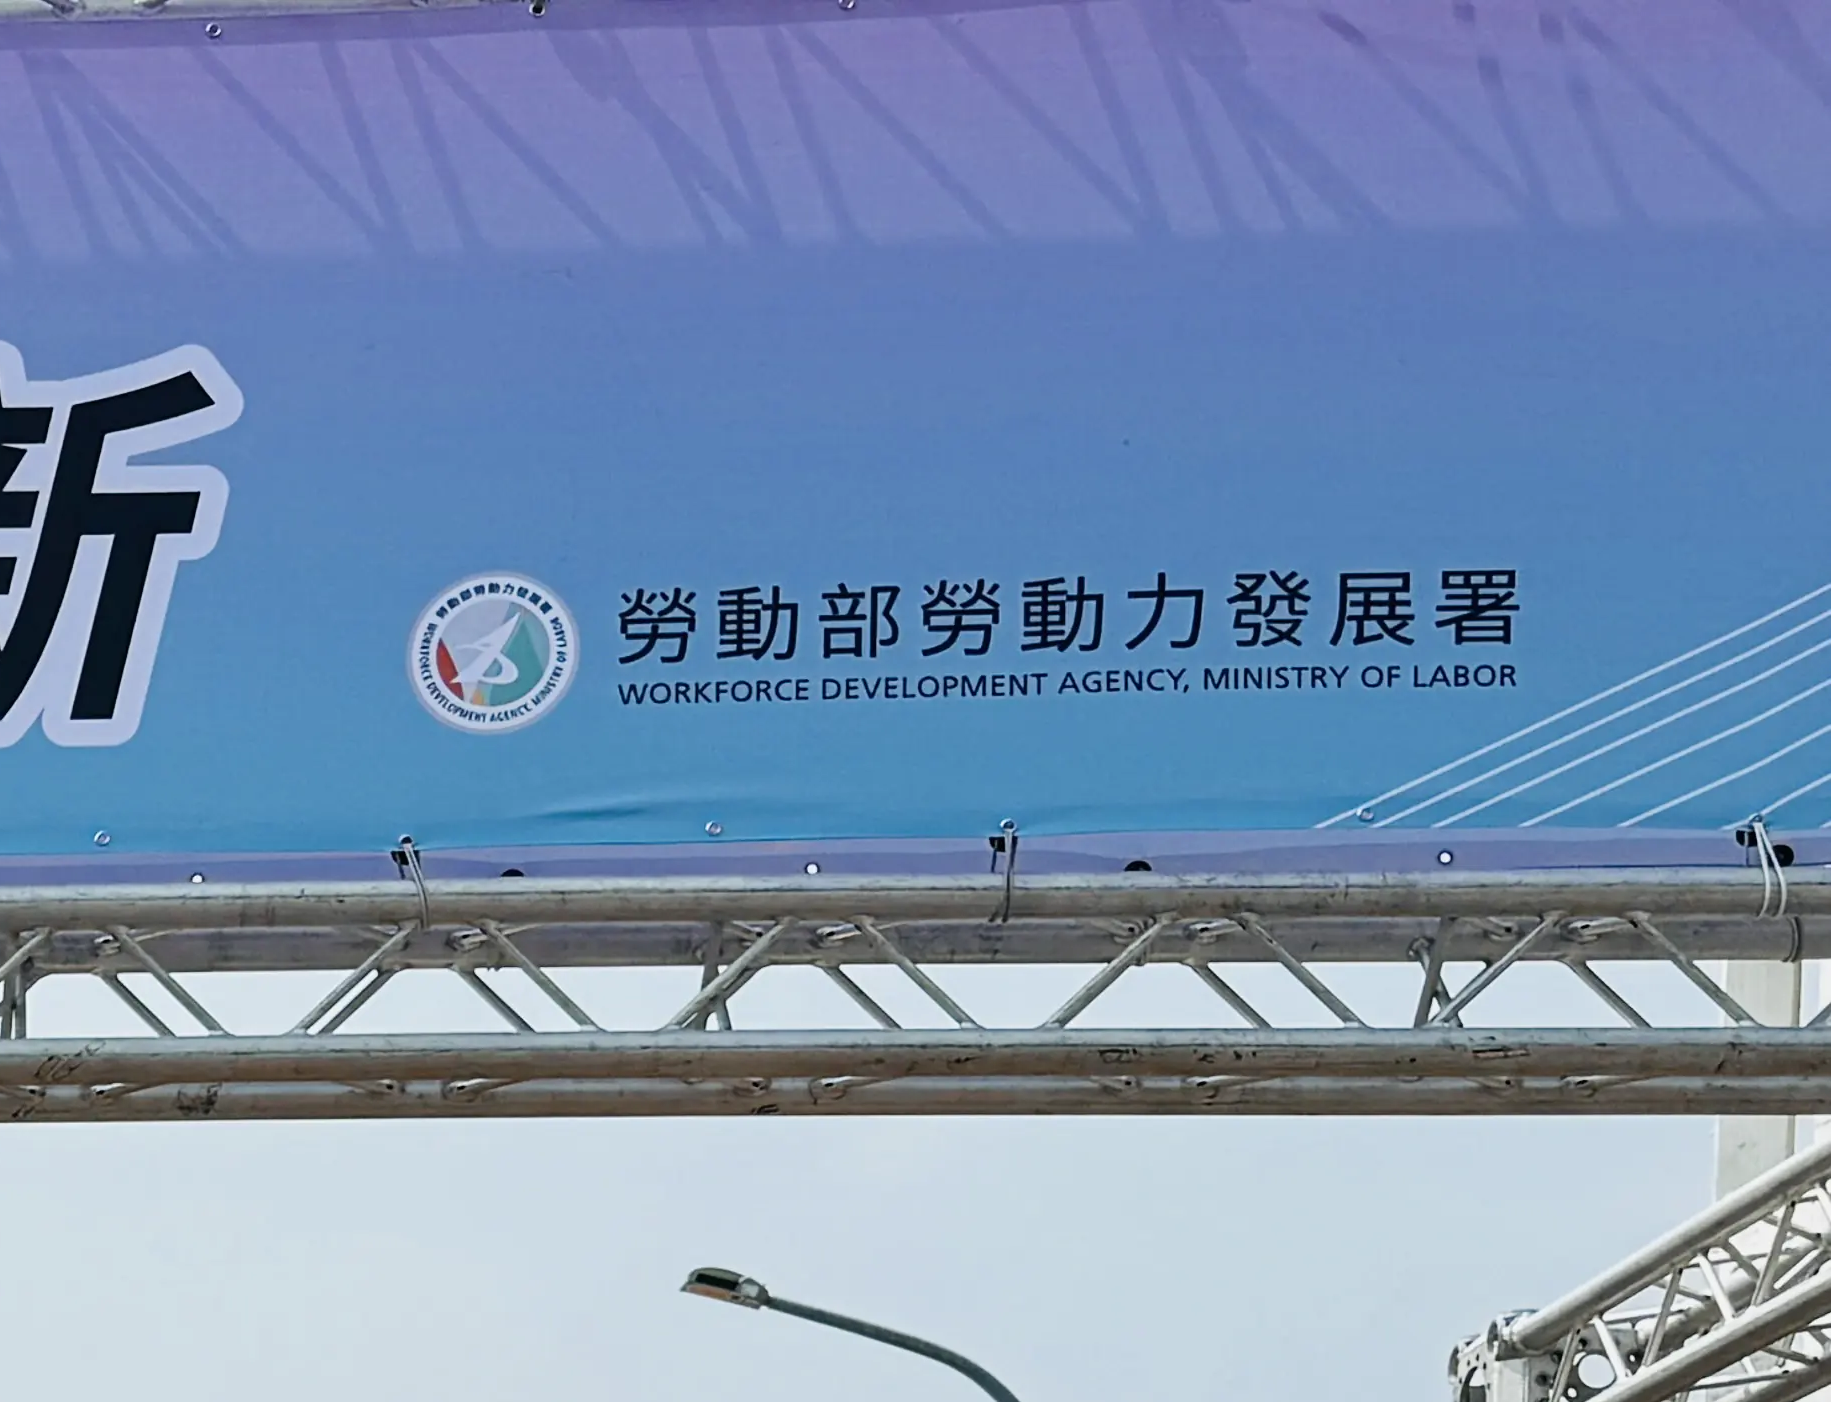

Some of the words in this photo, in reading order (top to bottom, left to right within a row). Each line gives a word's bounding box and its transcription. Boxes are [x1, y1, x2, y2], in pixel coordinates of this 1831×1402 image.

[618, 568, 1521, 665] 勞動部勞動力發展署
[618, 678, 811, 706] WORKFORCE
[821, 673, 1050, 702] DEVELOPMENT
[1058, 667, 1191, 696] AGENCY,
[1202, 665, 1350, 692] MINISTRY
[1360, 664, 1404, 688] OF
[1413, 662, 1518, 689] LABOR
